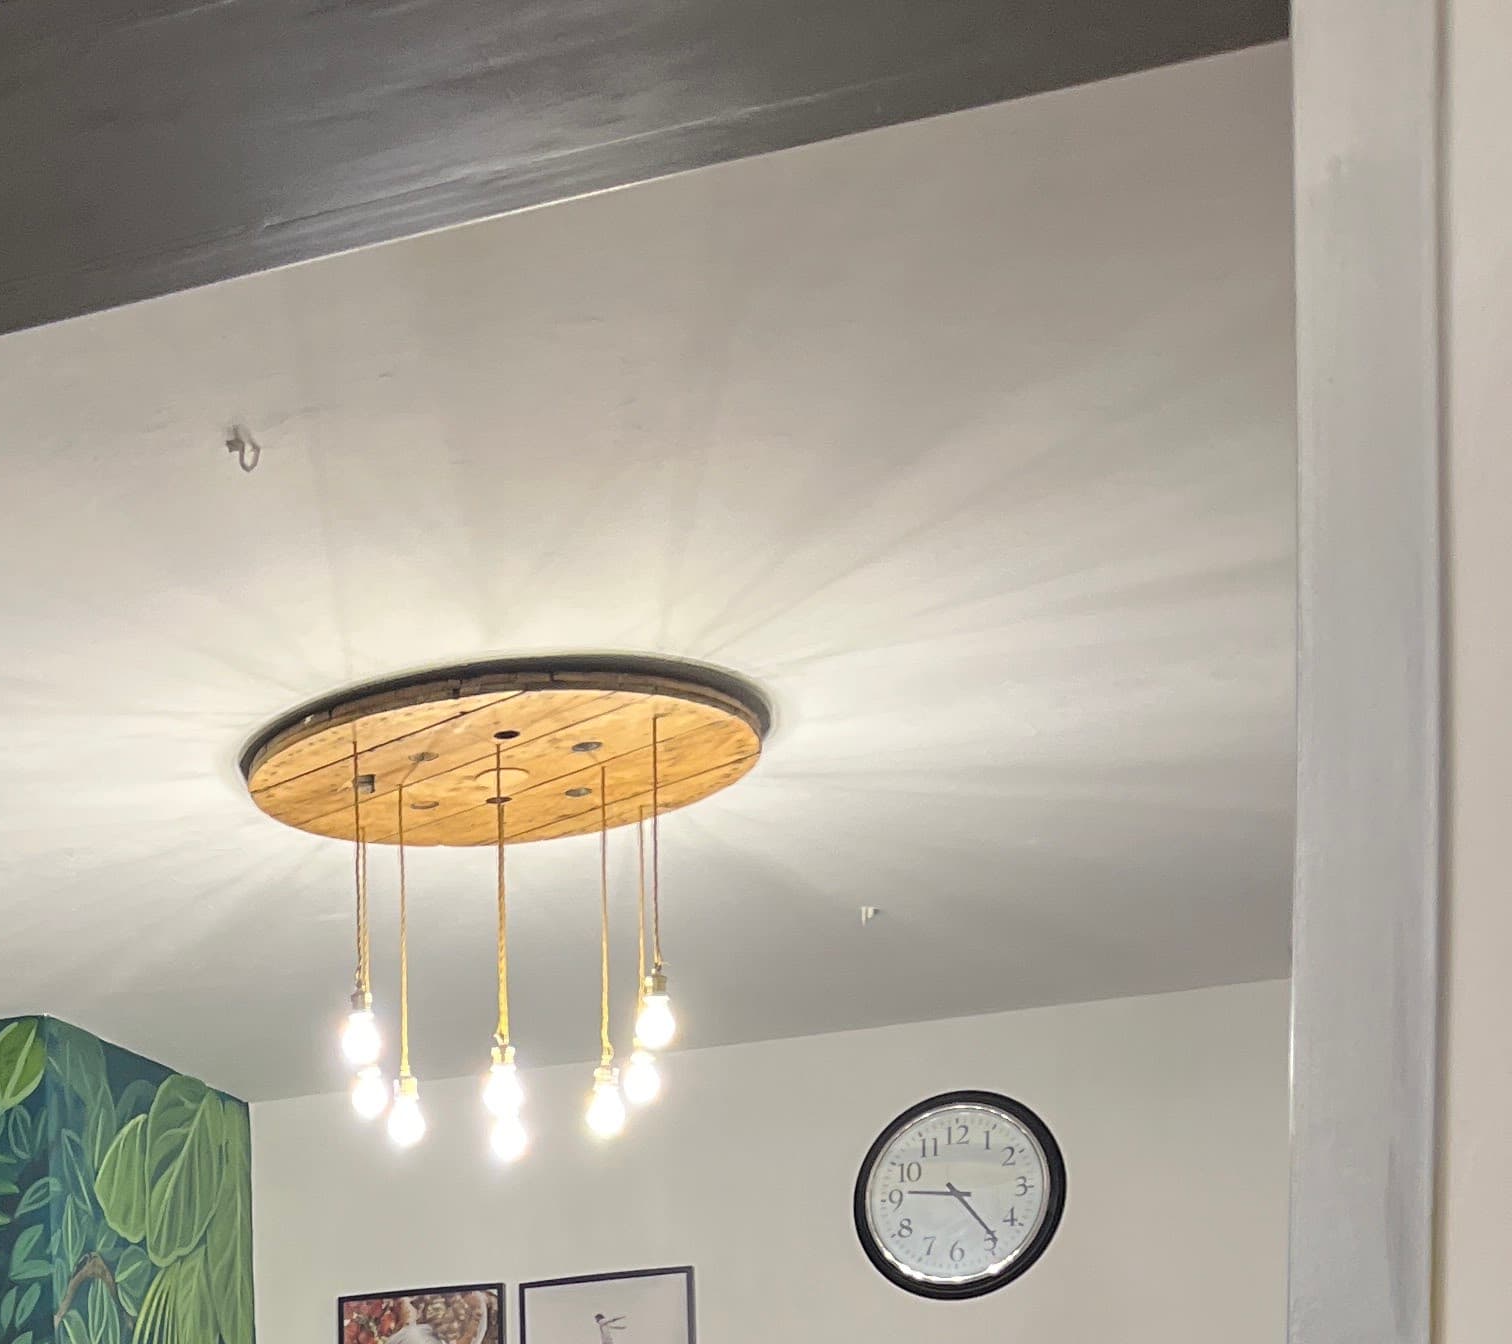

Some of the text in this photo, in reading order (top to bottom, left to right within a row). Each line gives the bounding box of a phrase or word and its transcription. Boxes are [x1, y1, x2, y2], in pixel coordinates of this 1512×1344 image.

[946, 1125, 969, 1145] 12
[984, 1130, 991, 1150] 1
[920, 1137, 939, 1158] 11
[1001, 1146, 1016, 1167] 2
[898, 1161, 921, 1183] 10
[1015, 1176, 1028, 1196] 3
[888, 1189, 903, 1212] 9
[1002, 1206, 1018, 1227] 4
[897, 1218, 913, 1238] 8
[923, 1236, 936, 1256] 7
[950, 1240, 965, 1262] 6
[984, 1230, 997, 1251] 5
